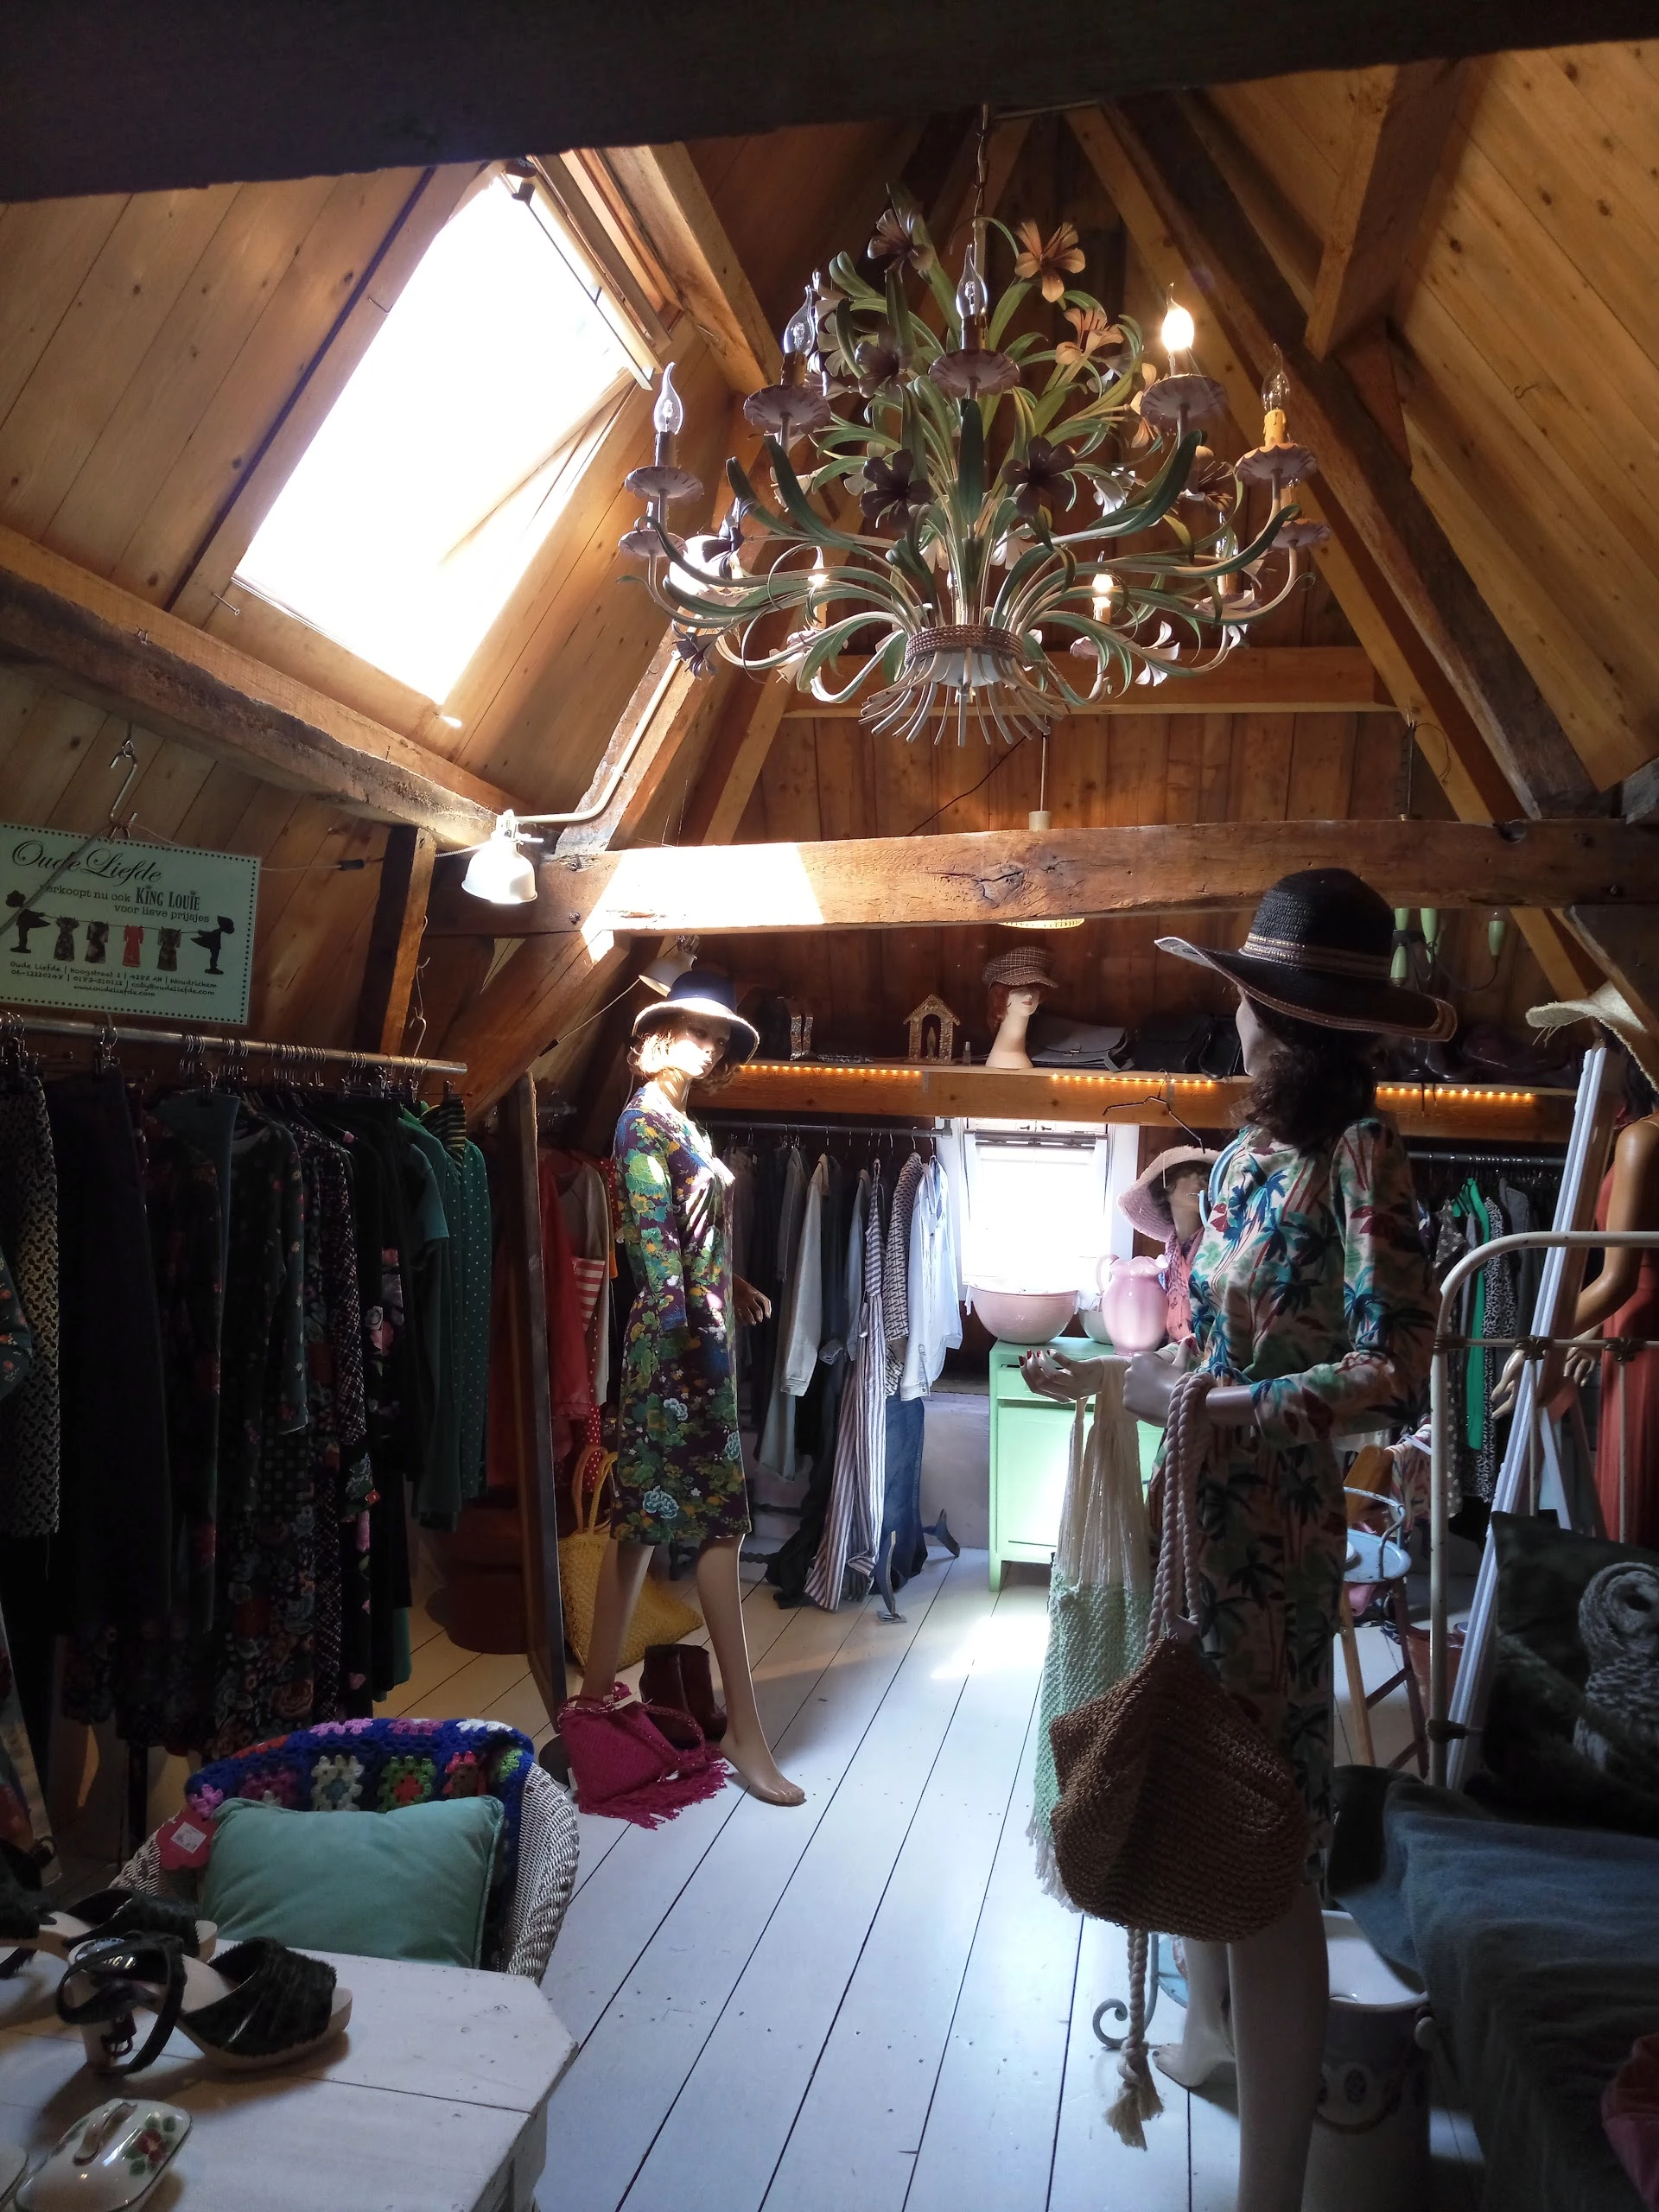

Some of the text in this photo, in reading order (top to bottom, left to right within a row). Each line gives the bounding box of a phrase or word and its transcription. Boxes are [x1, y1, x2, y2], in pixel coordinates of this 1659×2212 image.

[81, 849, 162, 887] Liefde
[93, 891, 108, 899] nu
[111, 893, 131, 903] ook
[136, 887, 164, 906] KING
[168, 891, 200, 911] LOUIE
[114, 905, 210, 923] voor lieve prijsjes
[10, 961, 31, 969] Oude
[35, 963, 60, 972] Liefde
[70, 968, 113, 977] Hoogstraat
[170, 978, 217, 988] Woudrichem
[73, 985, 156, 996] www.oudeliefde.com
